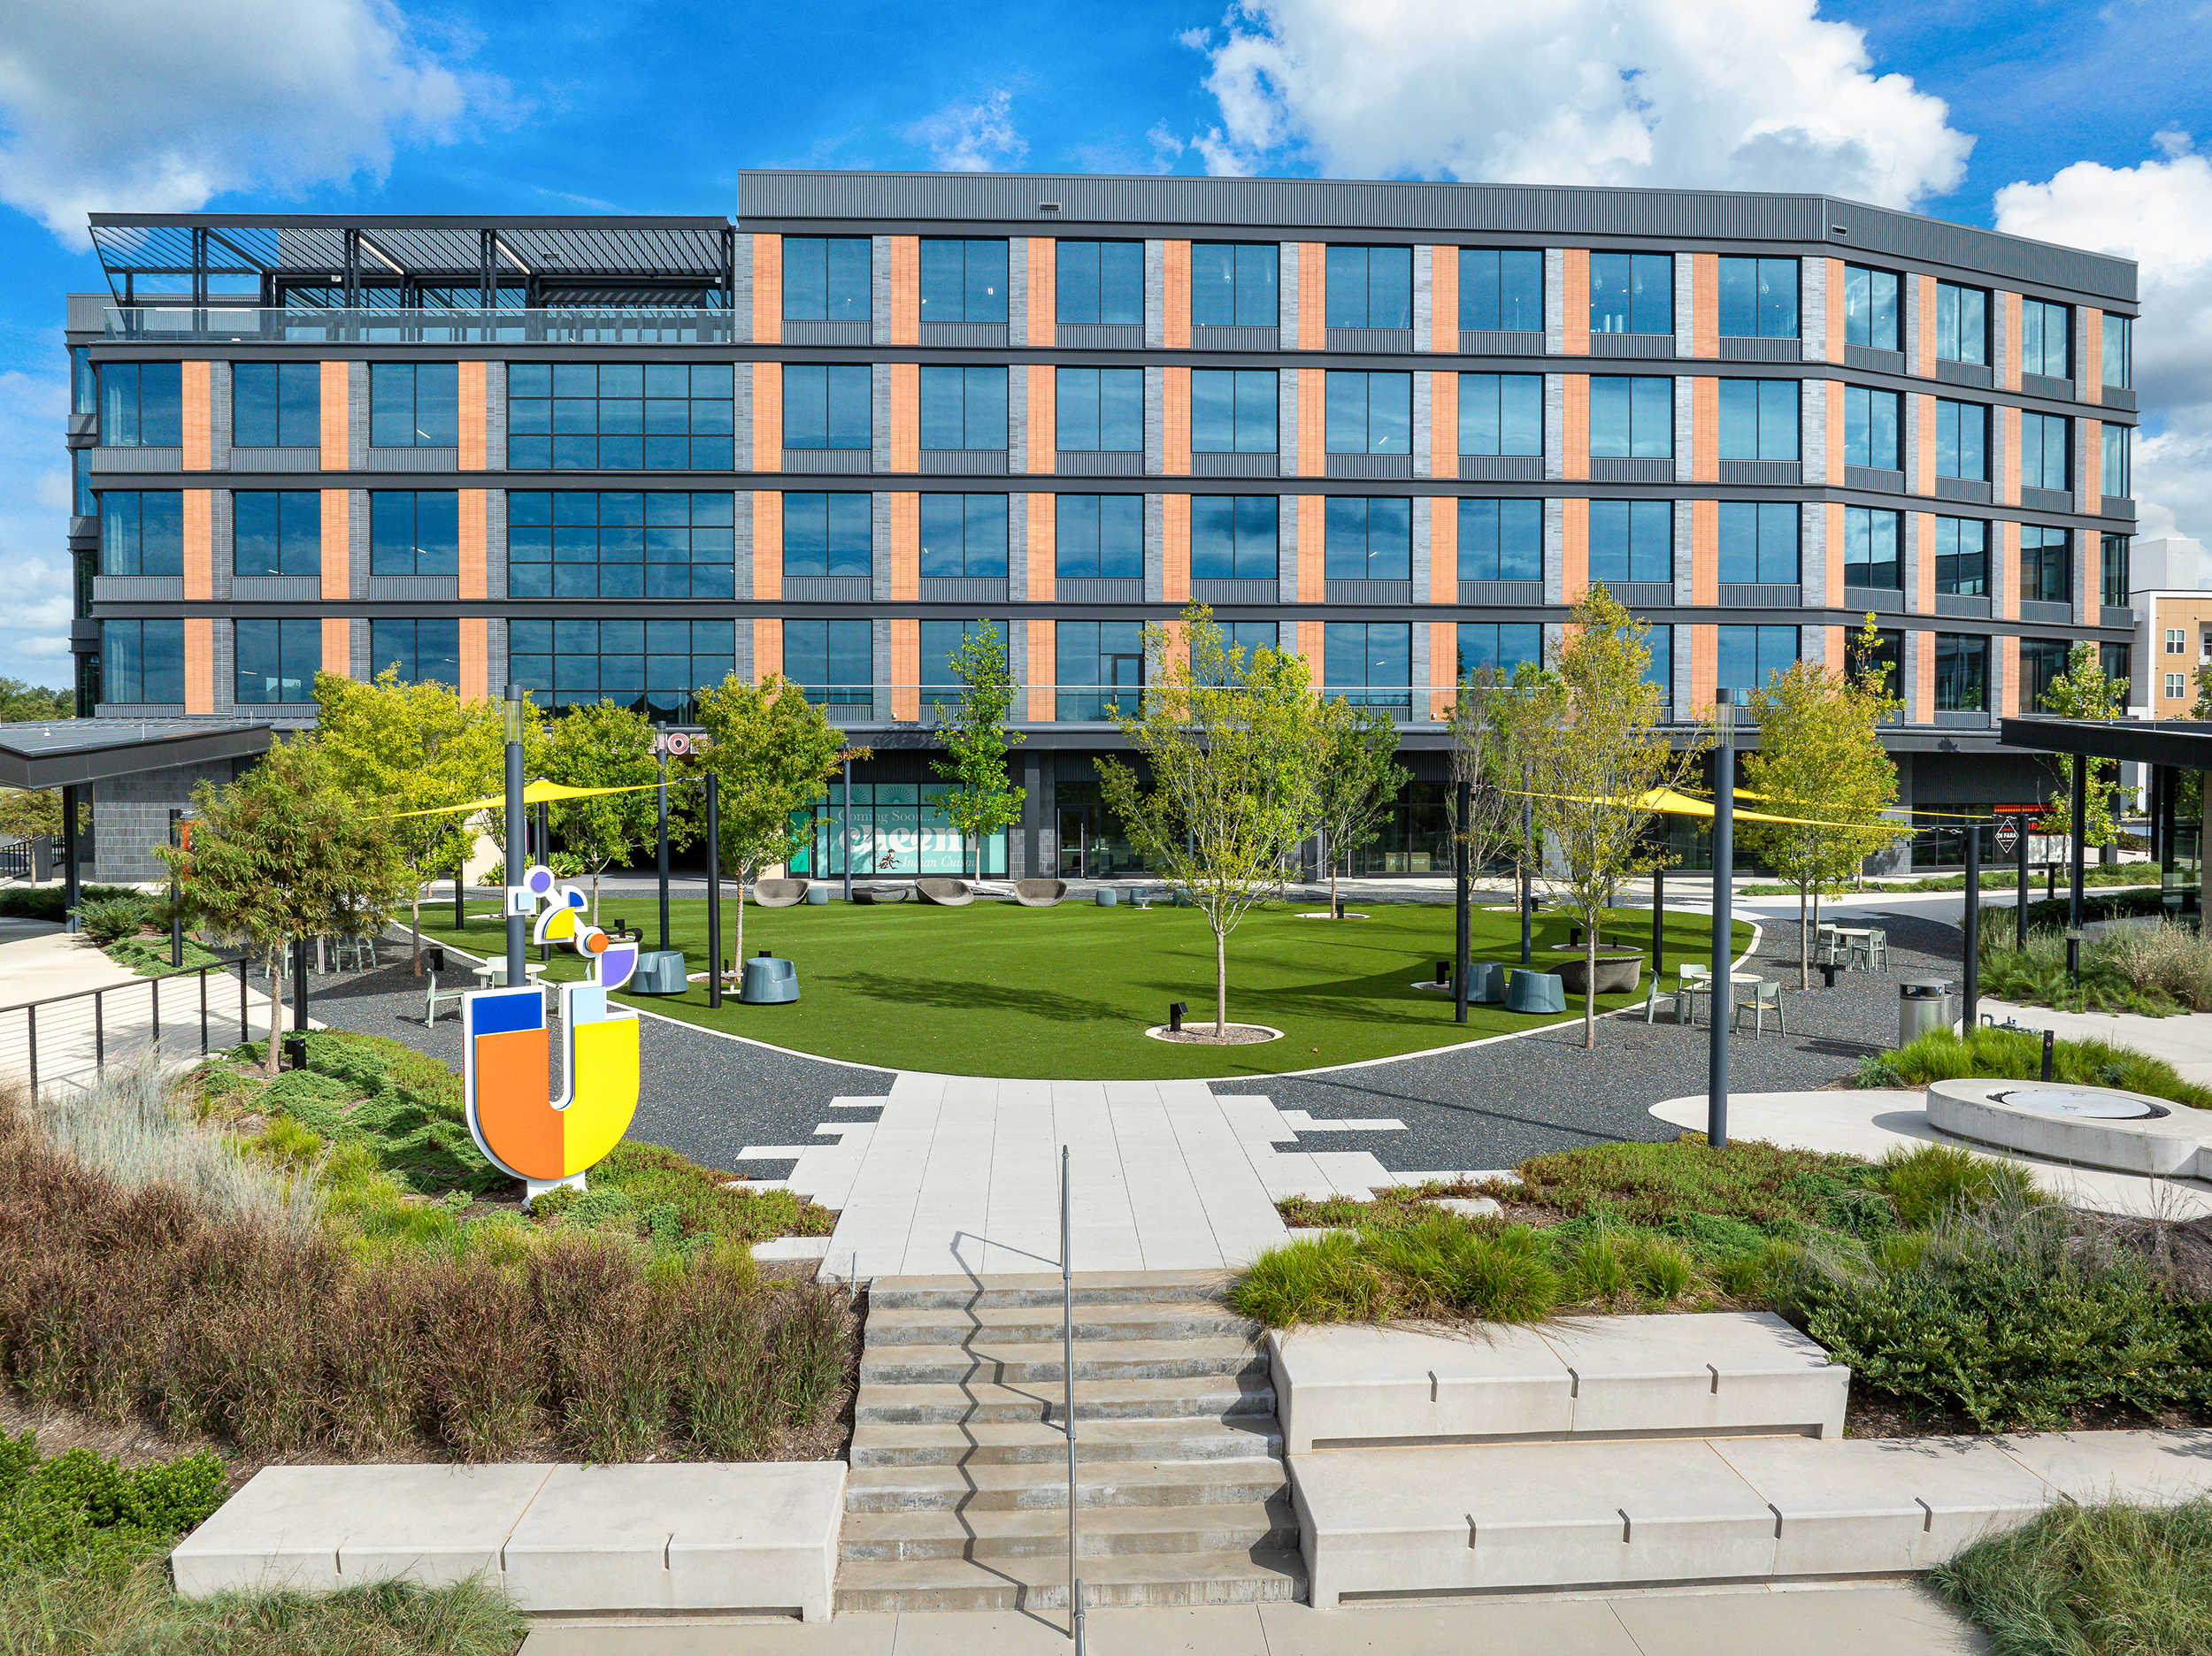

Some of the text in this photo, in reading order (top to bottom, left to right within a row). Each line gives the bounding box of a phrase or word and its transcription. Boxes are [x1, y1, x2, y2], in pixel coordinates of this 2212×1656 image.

[838, 809, 934, 824] Coming Soon...
[902, 855, 976, 868] Indian Cuisin
